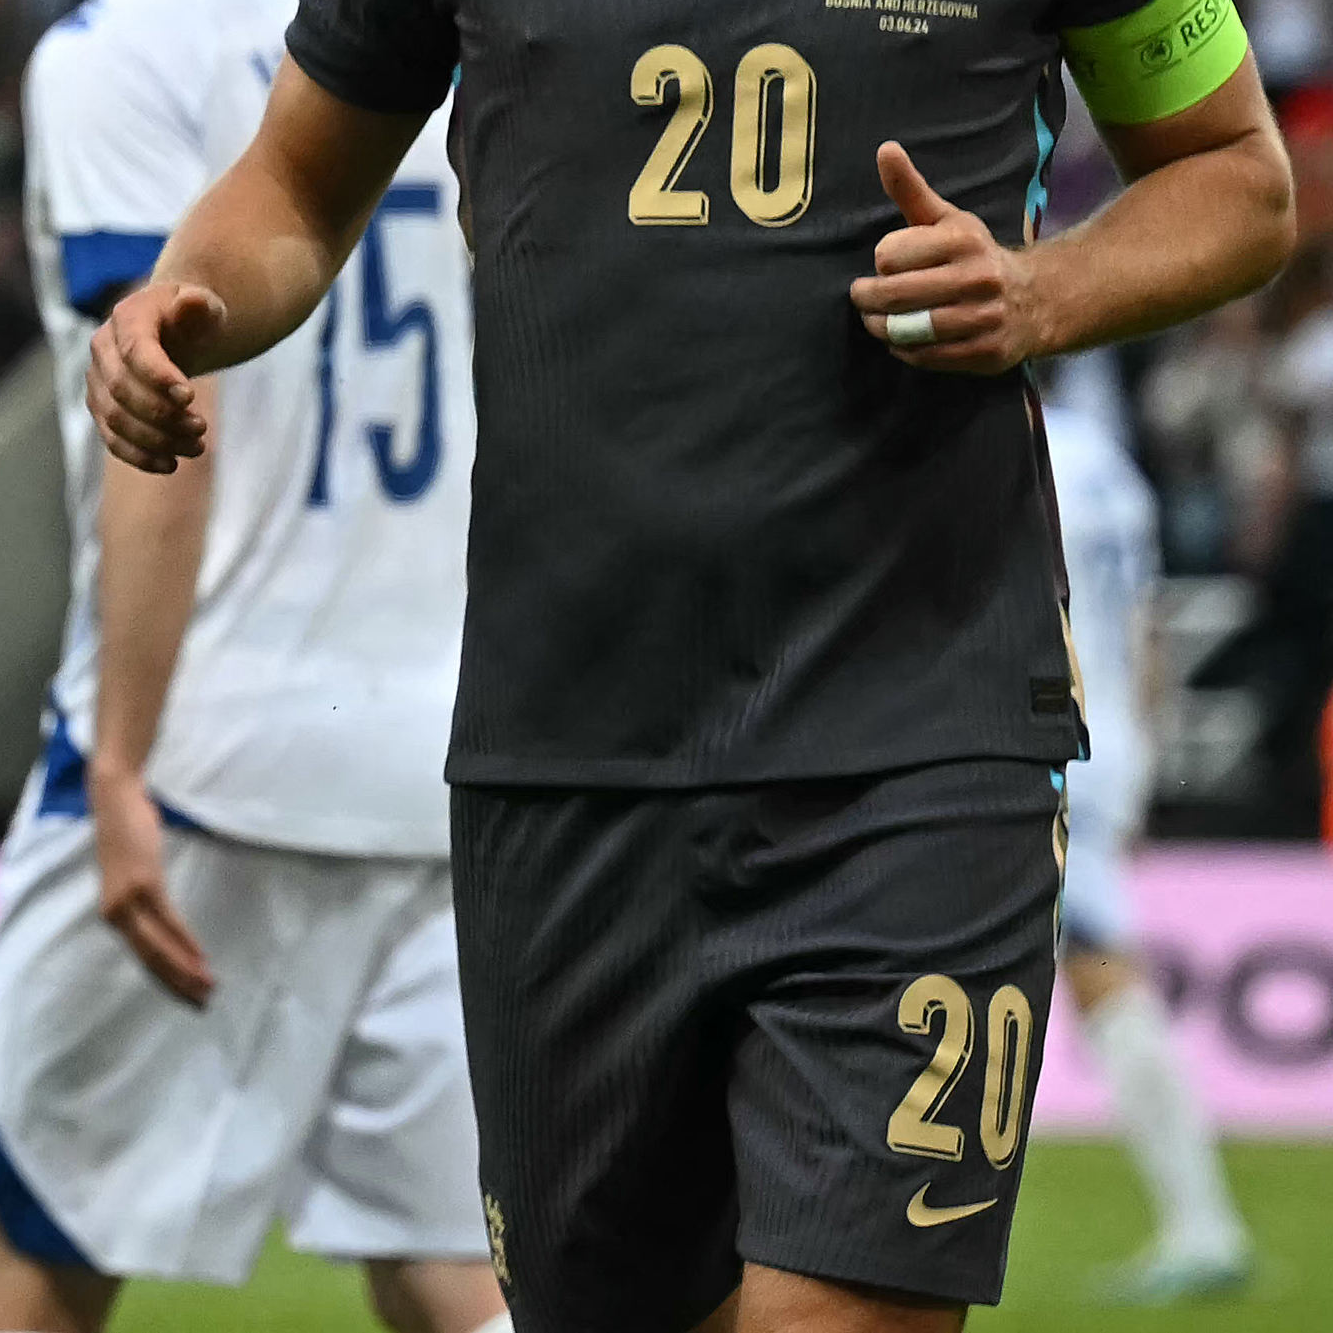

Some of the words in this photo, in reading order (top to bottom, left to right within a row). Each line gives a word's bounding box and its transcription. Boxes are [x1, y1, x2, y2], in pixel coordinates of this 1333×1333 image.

[627, 42, 818, 228] 20
[306, 182, 443, 506] 15
[886, 973, 1034, 1171] 20
